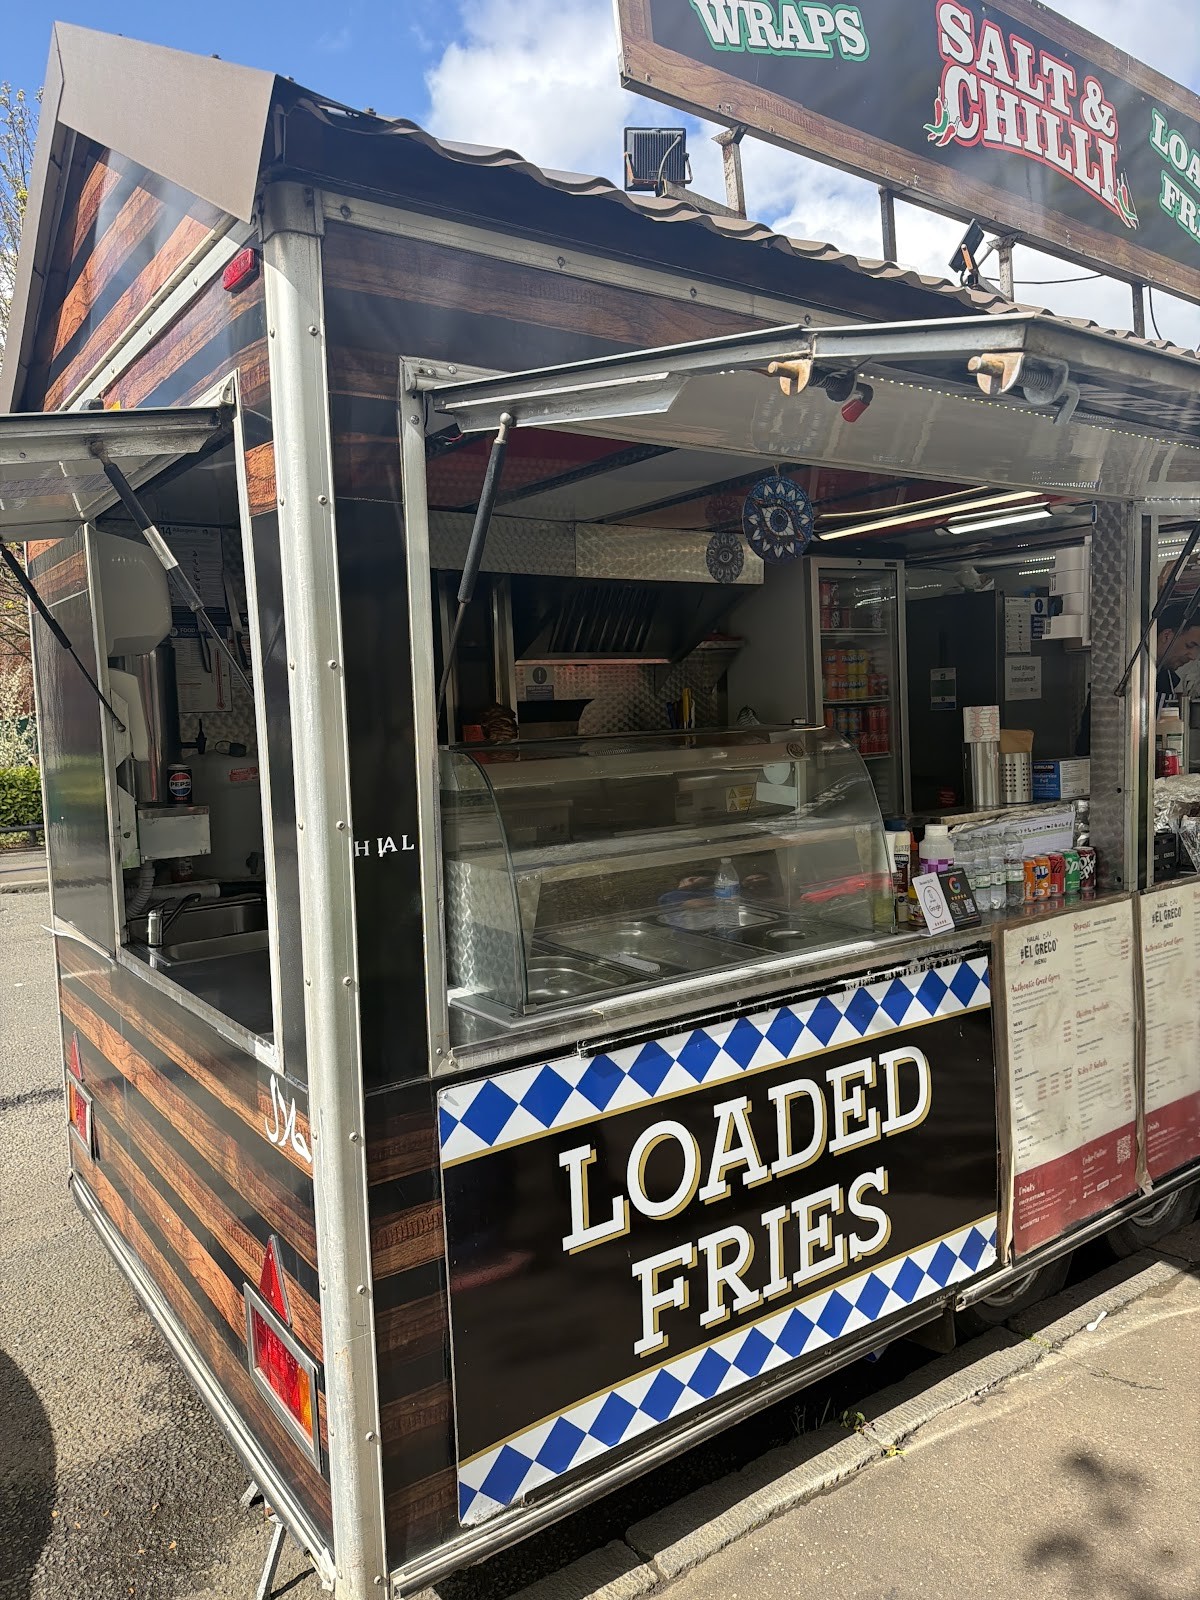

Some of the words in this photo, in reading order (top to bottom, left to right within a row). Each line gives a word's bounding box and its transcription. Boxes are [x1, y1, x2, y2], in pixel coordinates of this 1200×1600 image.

[691, 0, 868, 59] WRAPS
[938, 2, 1075, 117] SALT
[1081, 79, 1117, 138] &
[942, 64, 1117, 208] CHILLI
[1161, 173, 1200, 238] FR
[160, 526, 172, 536] 14
[1163, 906, 1182, 921] GRECO
[1034, 939, 1057, 956] GRECO
[1011, 980, 1035, 993] Authentic
[558, 1045, 932, 1254] LOADED
[631, 1166, 892, 1357] FRIES
